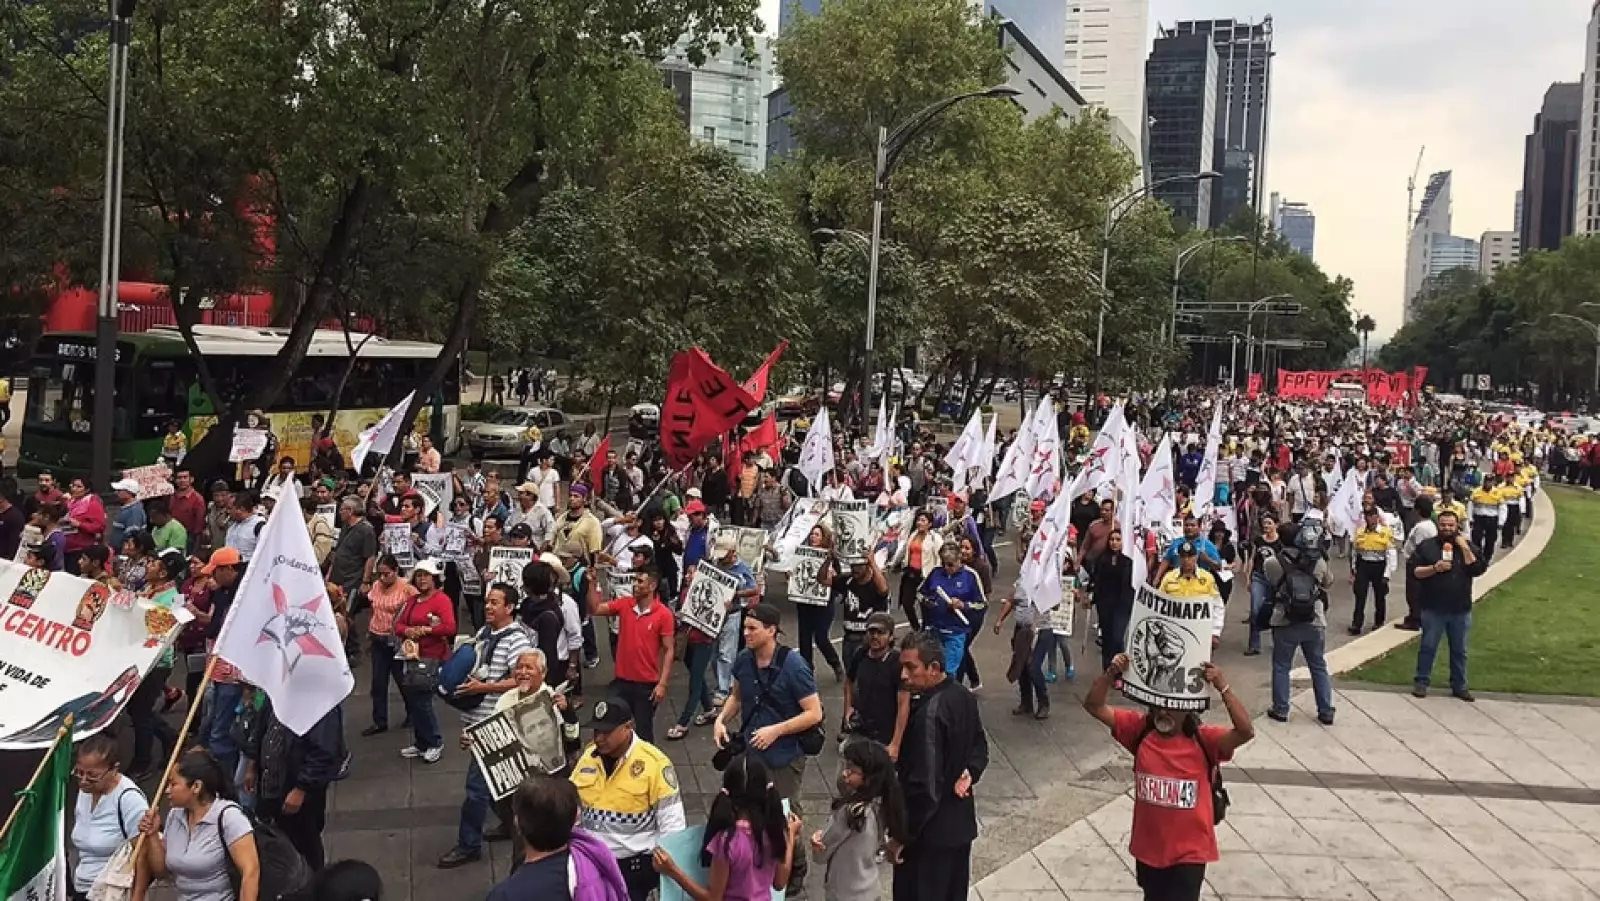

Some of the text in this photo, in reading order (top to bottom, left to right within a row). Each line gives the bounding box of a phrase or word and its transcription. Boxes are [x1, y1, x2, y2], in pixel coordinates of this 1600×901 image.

[4, 610, 92, 656] CENTRO
[4, 664, 33, 684] VIDA
[29, 674, 52, 689] DE
[1167, 666, 1205, 694] 43
[1180, 781, 1195, 807] 43
